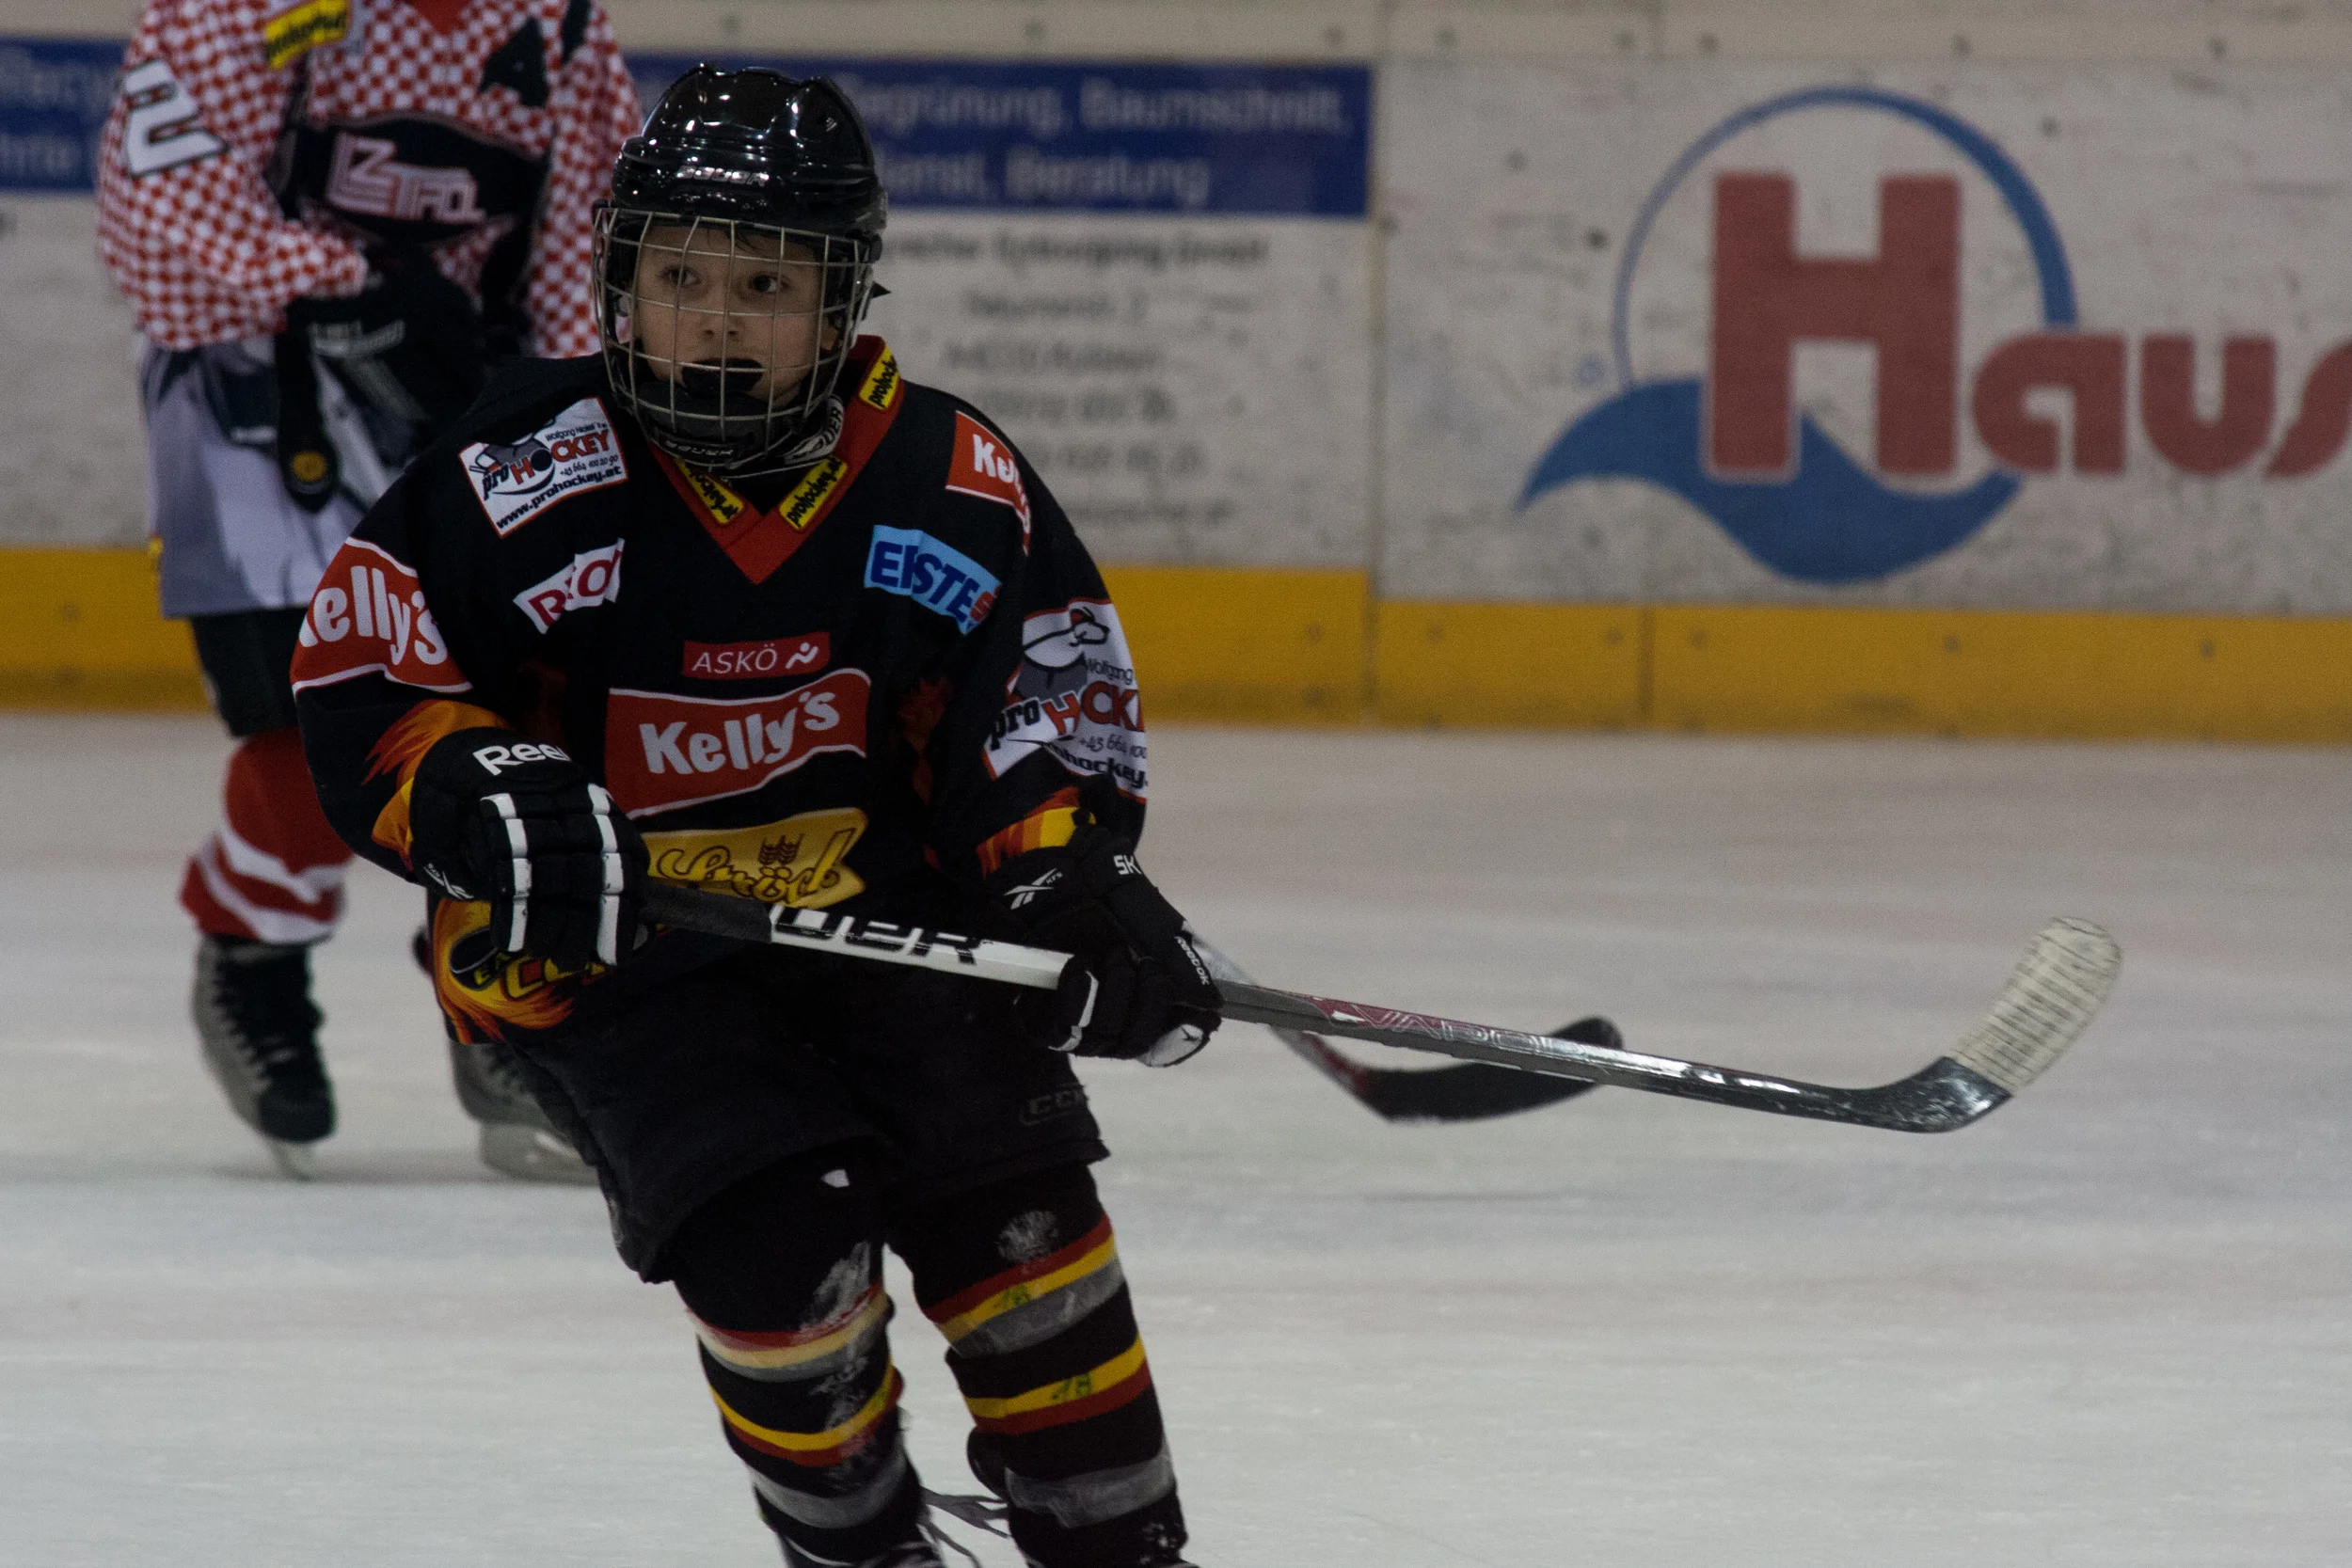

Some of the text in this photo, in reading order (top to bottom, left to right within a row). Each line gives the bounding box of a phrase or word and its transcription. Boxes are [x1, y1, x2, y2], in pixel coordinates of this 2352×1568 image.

[496, 466, 622, 530] www.prohockey.at
[691, 642, 778, 675] ASKÖ
[639, 691, 840, 774] Kelly's
